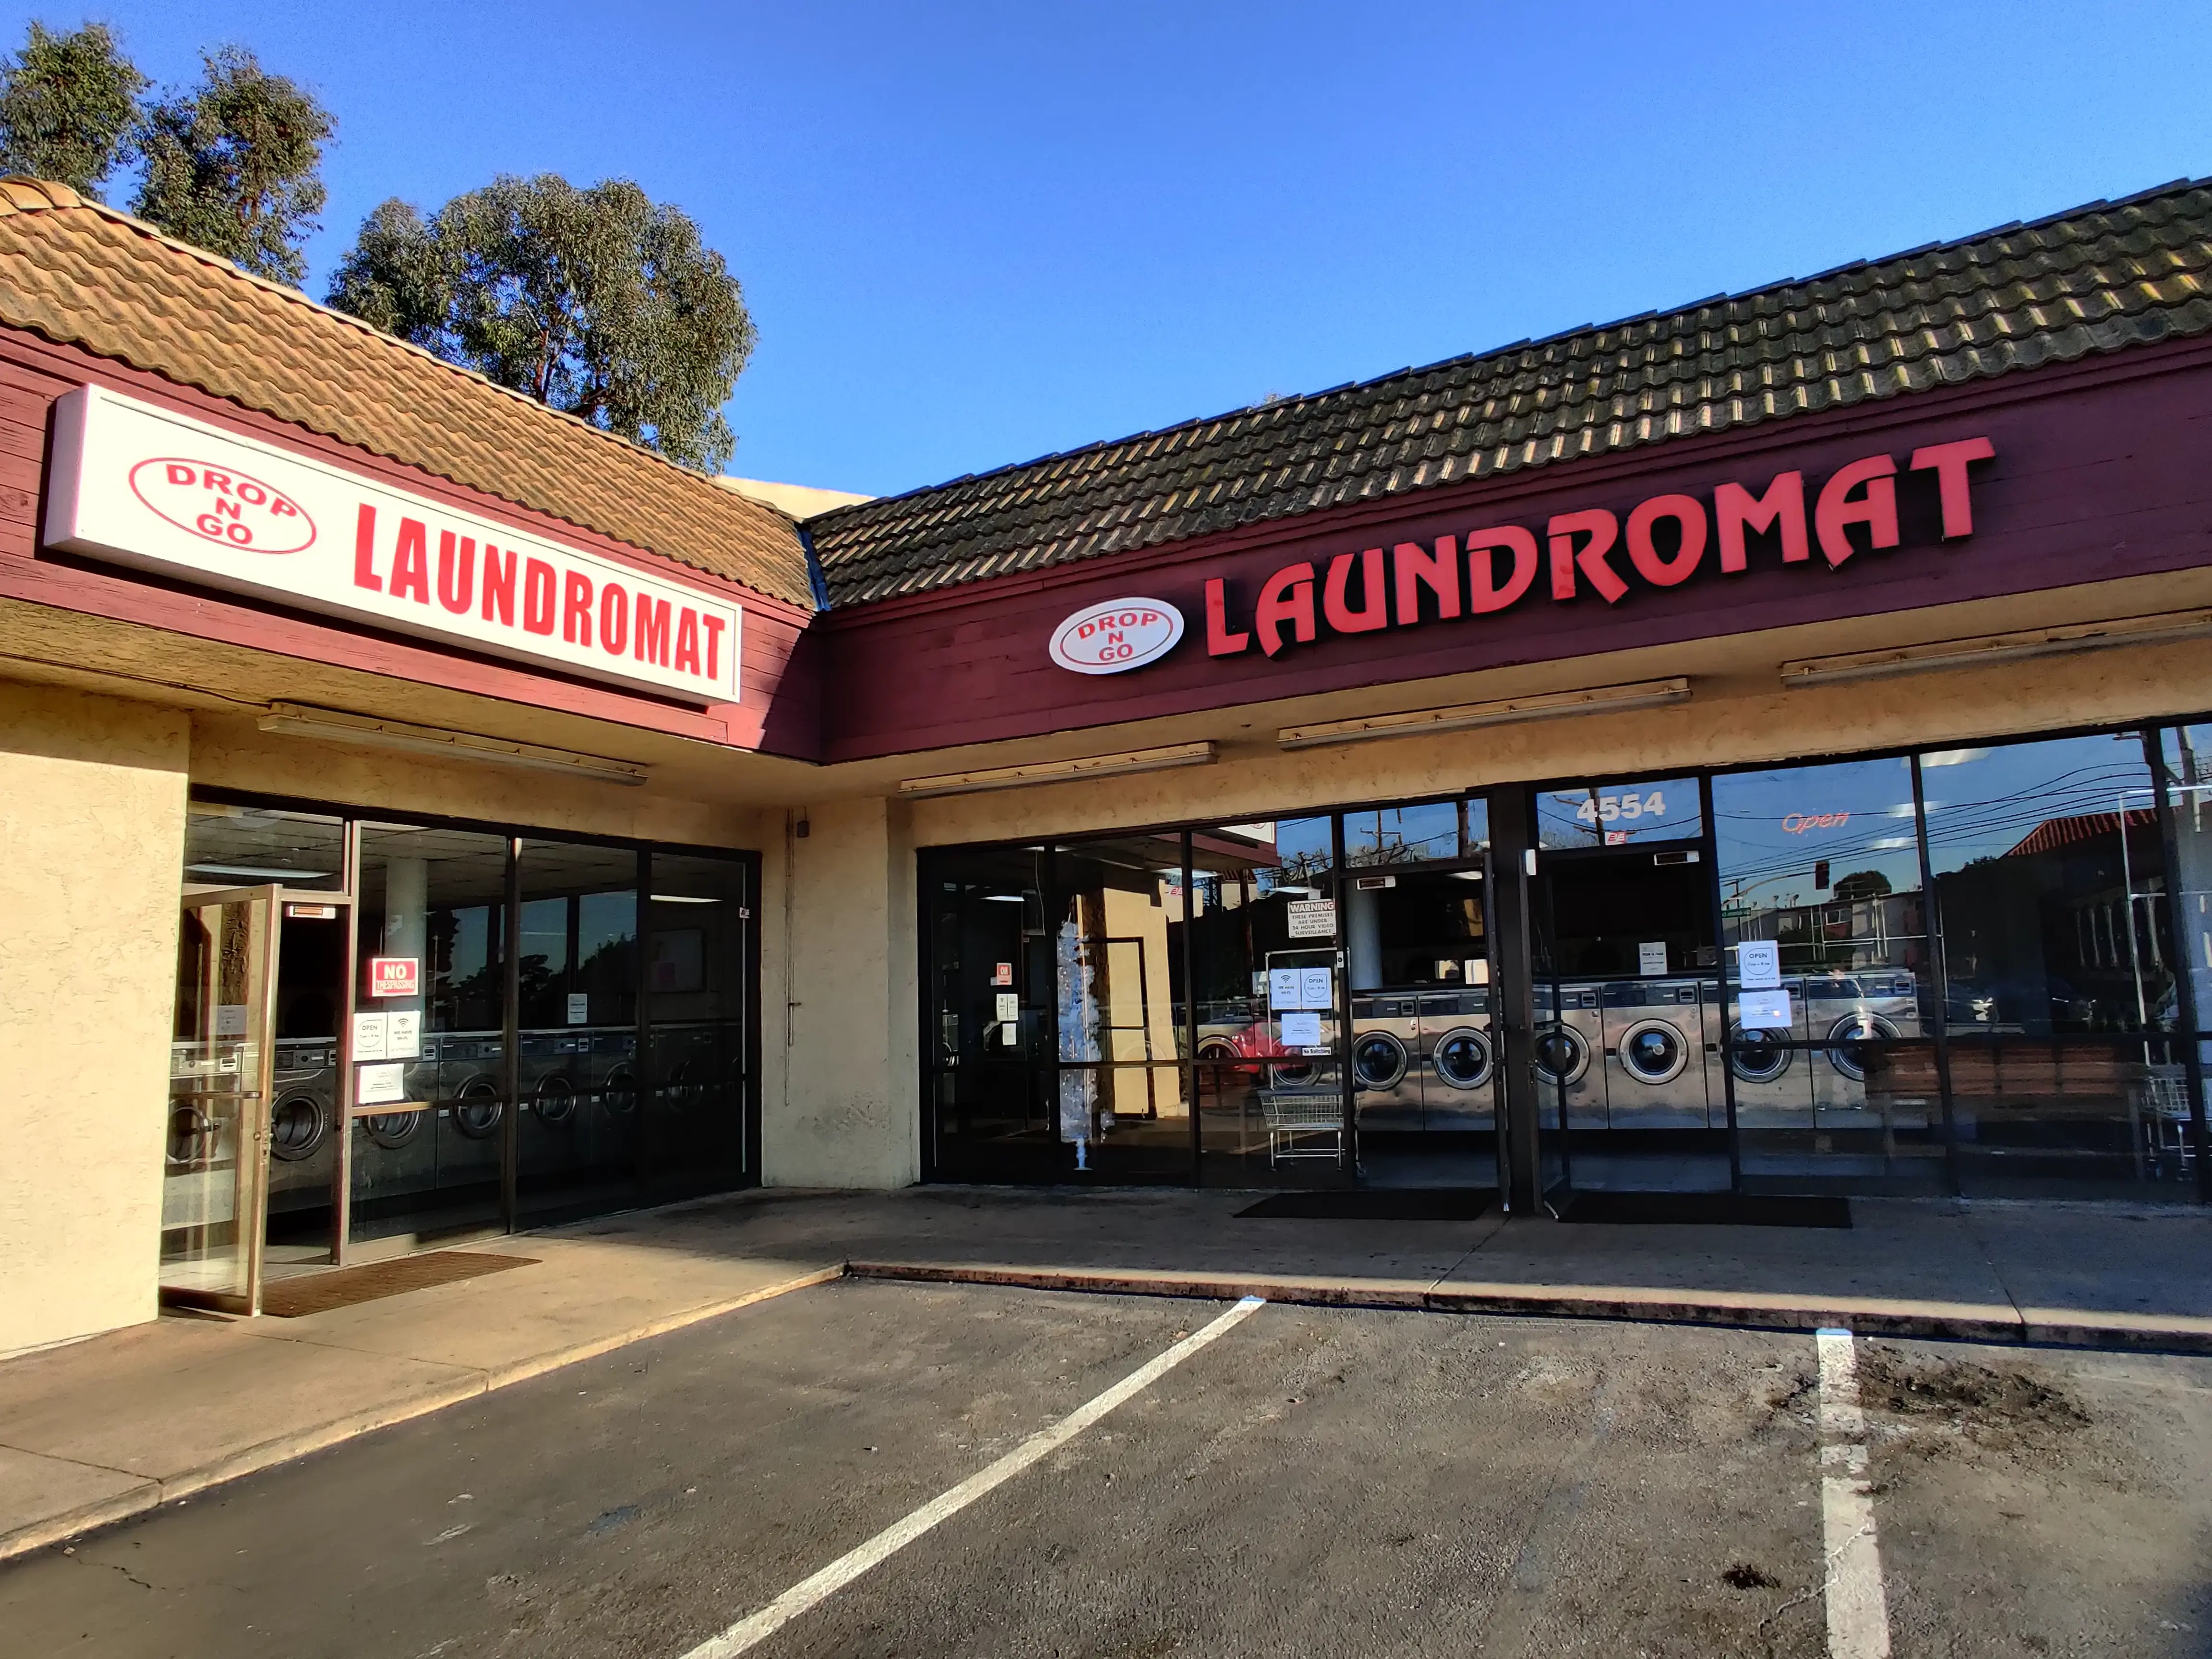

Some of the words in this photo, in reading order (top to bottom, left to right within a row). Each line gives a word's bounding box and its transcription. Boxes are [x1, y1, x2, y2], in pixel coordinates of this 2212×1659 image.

[166, 463, 298, 518] DROP
[216, 497, 241, 520] N
[196, 513, 253, 545] GO
[1205, 437, 1996, 657] LAUNDROMAT
[353, 503, 725, 681] LAUNDROMAT
[1078, 612, 1158, 640] DROP
[1108, 630, 1124, 645] N
[1099, 643, 1133, 662] GO
[1576, 791, 1666, 823] 4554
[1782, 812, 1850, 834] Open
[1290, 902, 1334, 913] WARNING
[384, 964, 407, 980] NO
